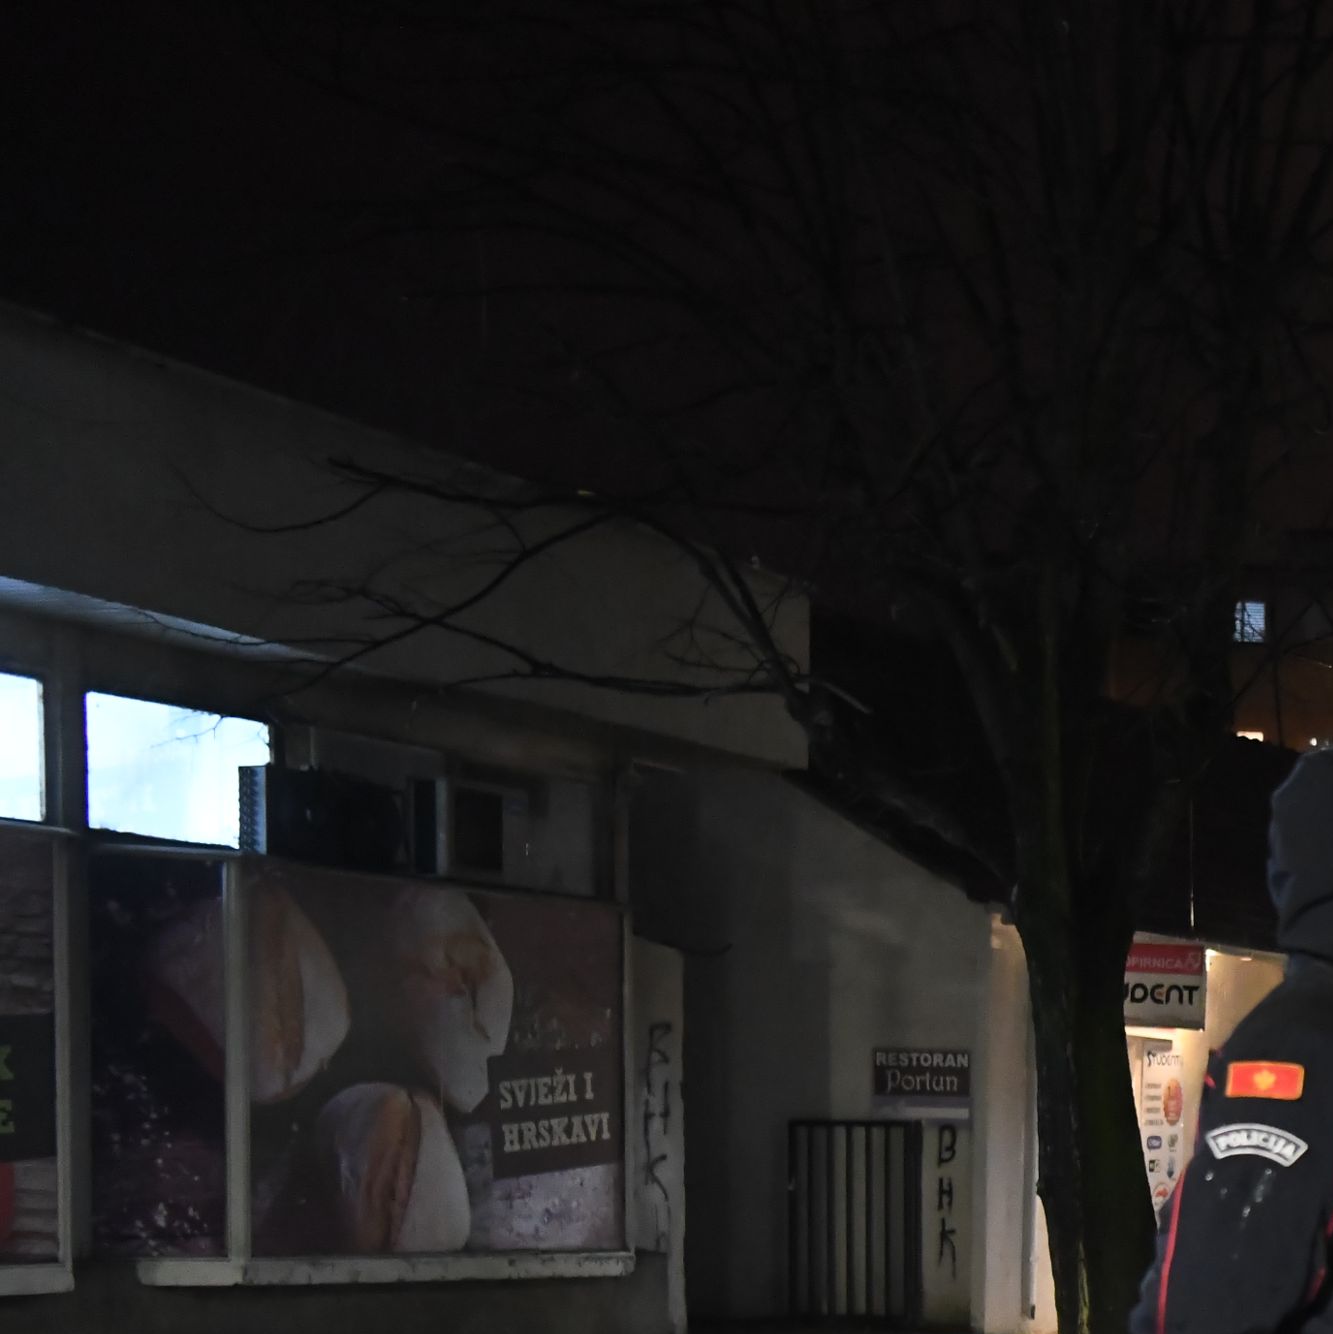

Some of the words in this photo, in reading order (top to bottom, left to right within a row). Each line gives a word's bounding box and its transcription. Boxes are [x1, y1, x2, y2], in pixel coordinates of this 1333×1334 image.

[876, 1051, 969, 1068] RESTORAN
[499, 1064, 578, 1110] SVJEŽI
[583, 1071, 595, 1100] I
[501, 1111, 611, 1153] HRSKAVI
